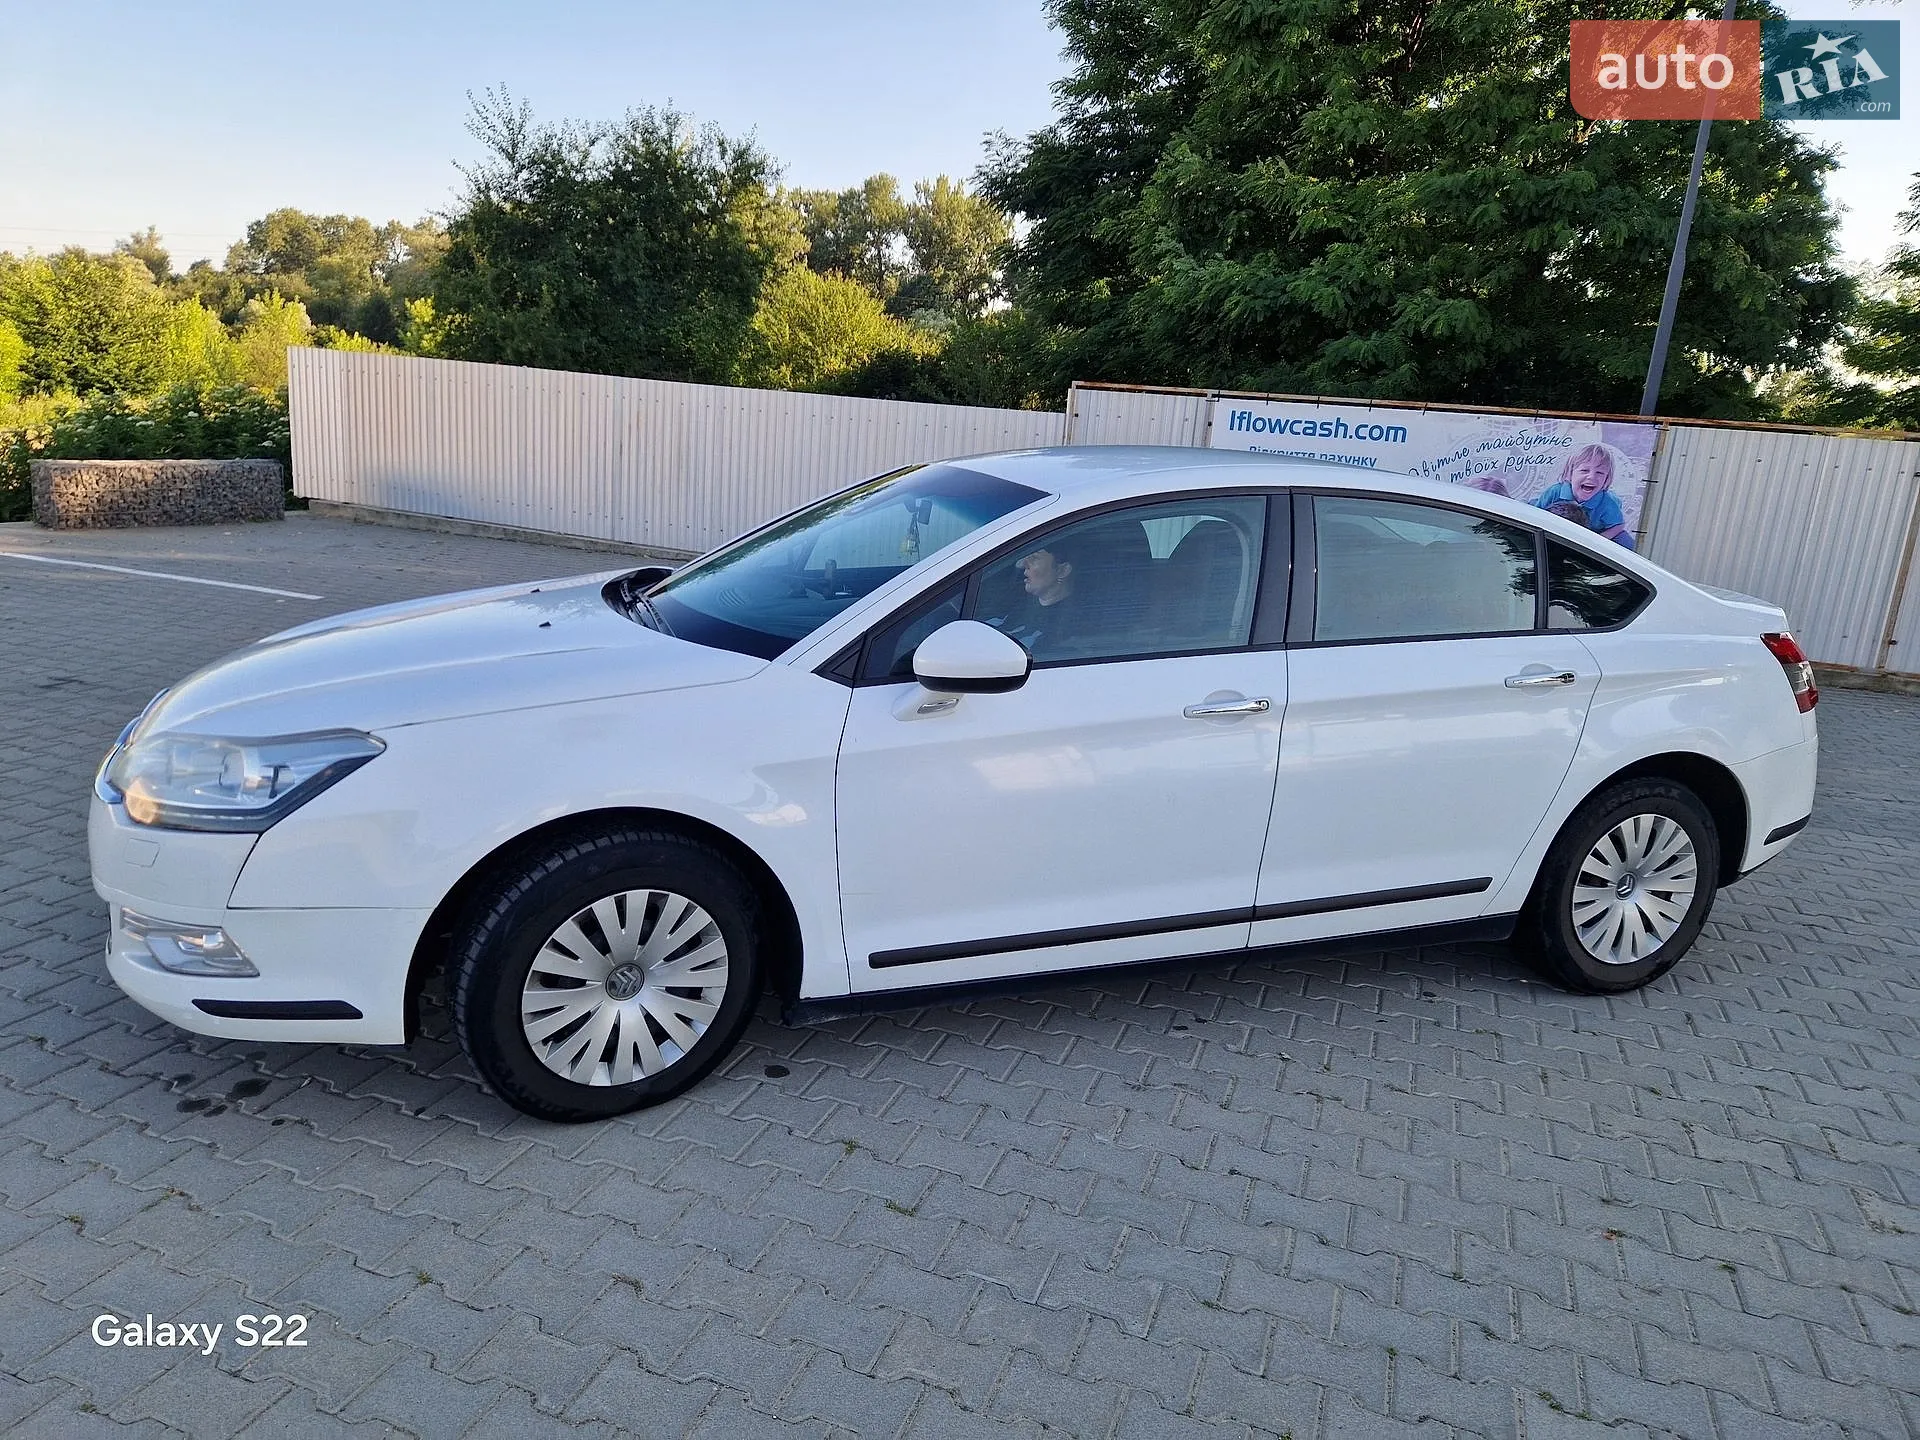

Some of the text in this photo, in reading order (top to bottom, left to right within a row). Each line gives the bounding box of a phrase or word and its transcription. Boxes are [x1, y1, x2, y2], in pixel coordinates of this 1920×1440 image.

[1476, 429, 1573, 452] майбутнє
[1450, 452, 1557, 483] твоїх руках
